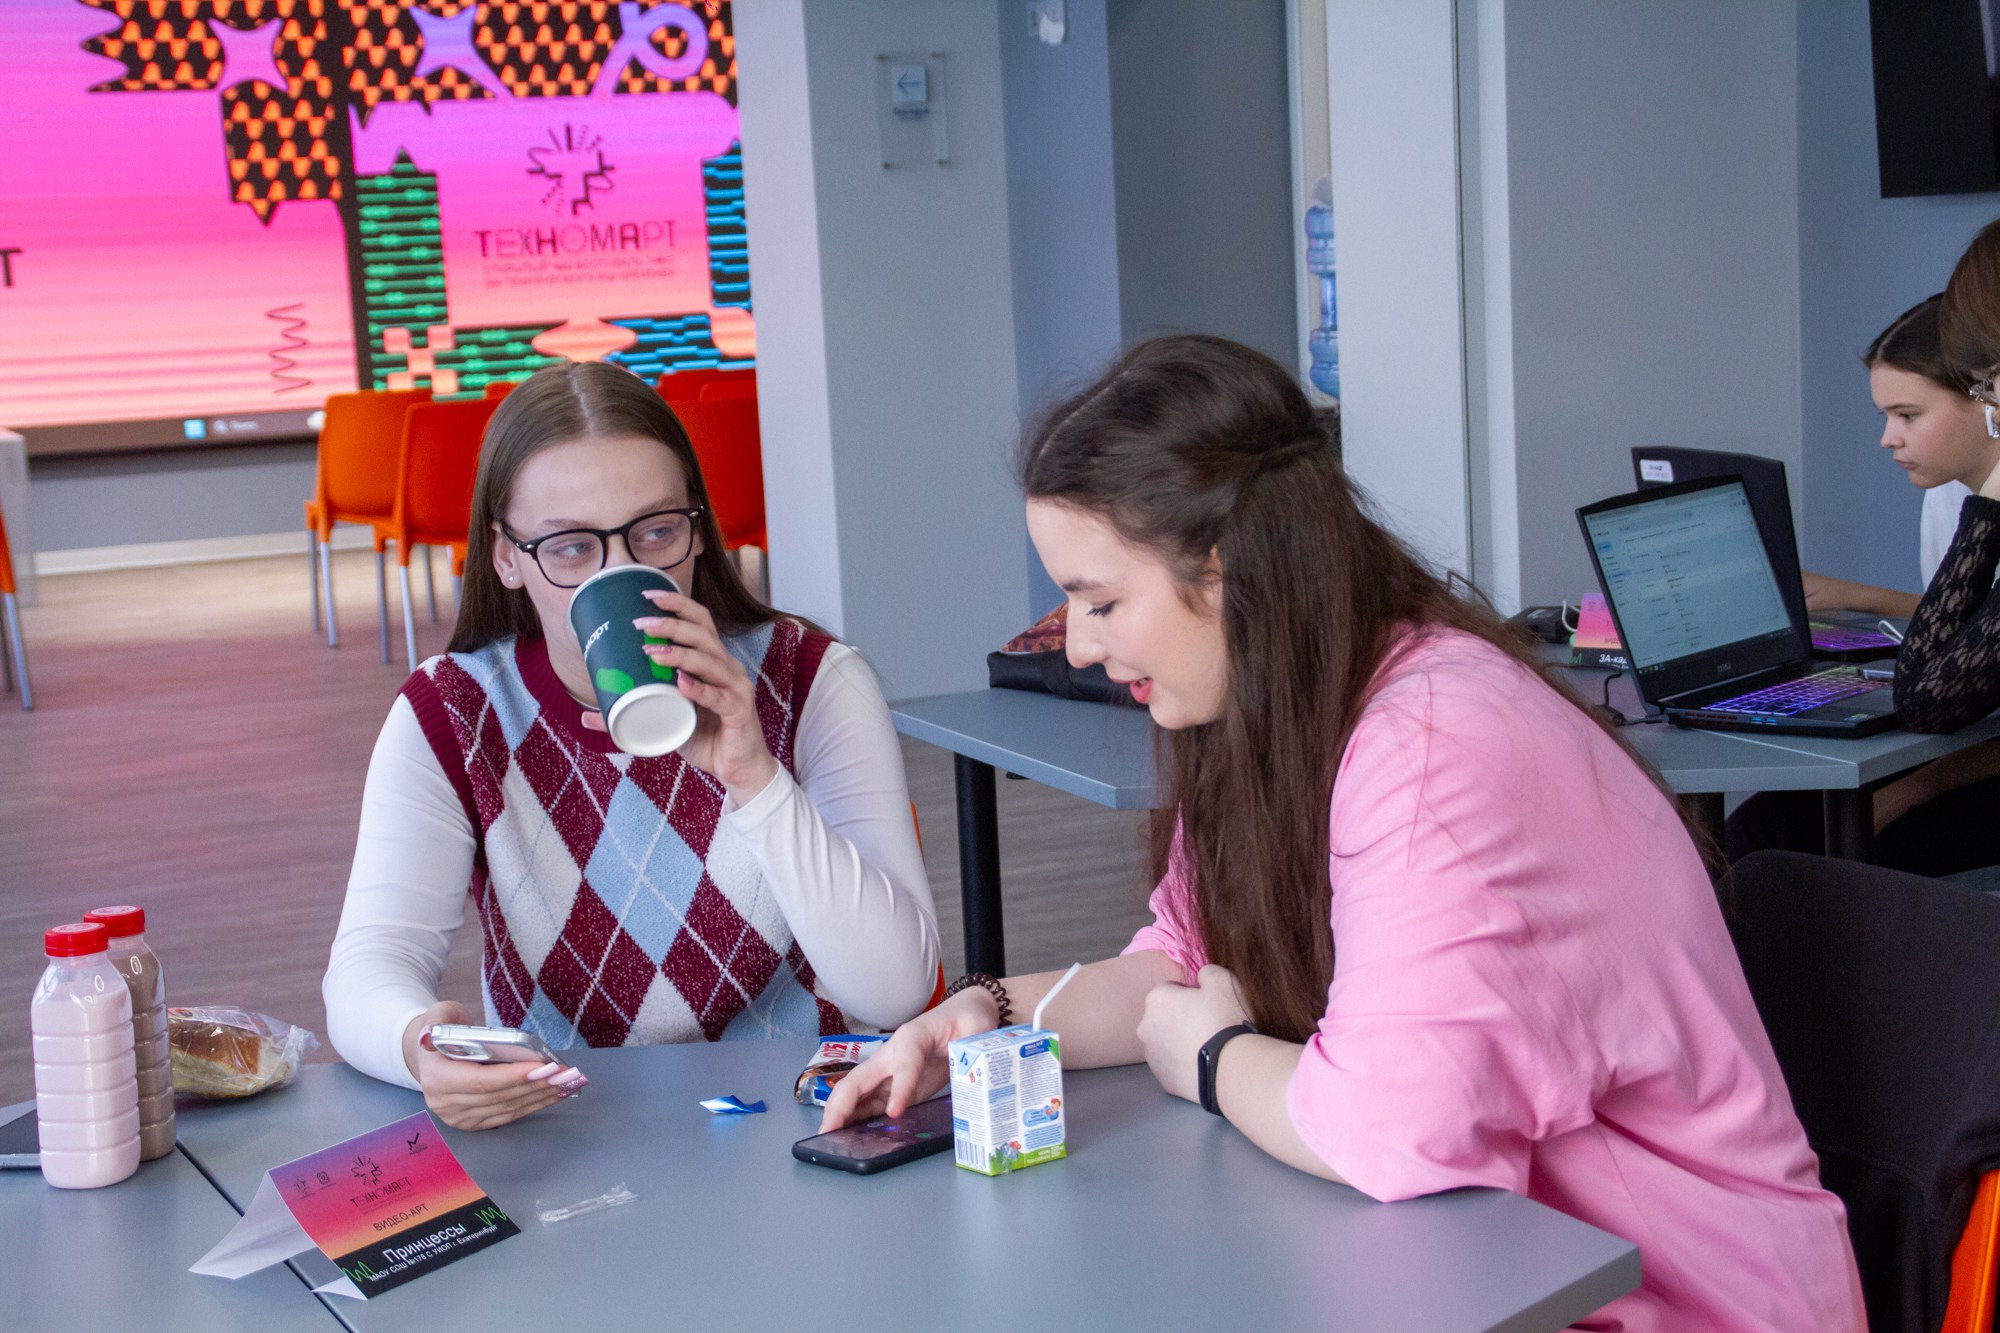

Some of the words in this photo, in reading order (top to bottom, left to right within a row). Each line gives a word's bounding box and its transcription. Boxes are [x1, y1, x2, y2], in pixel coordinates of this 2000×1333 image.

[473, 220, 676, 257] ТЕХНОМАРТ
[350, 1176, 412, 1208] ТЕХНОМАРТ
[373, 1203, 429, 1231] ВИДЕО-АРТ
[369, 1270, 390, 1282] МАОУ
[390, 1261, 407, 1273] СОШ
[432, 1242, 452, 1255] УИОП
[458, 1224, 498, 1245] Екатеринбург
[382, 1223, 467, 1262] Принцессы
